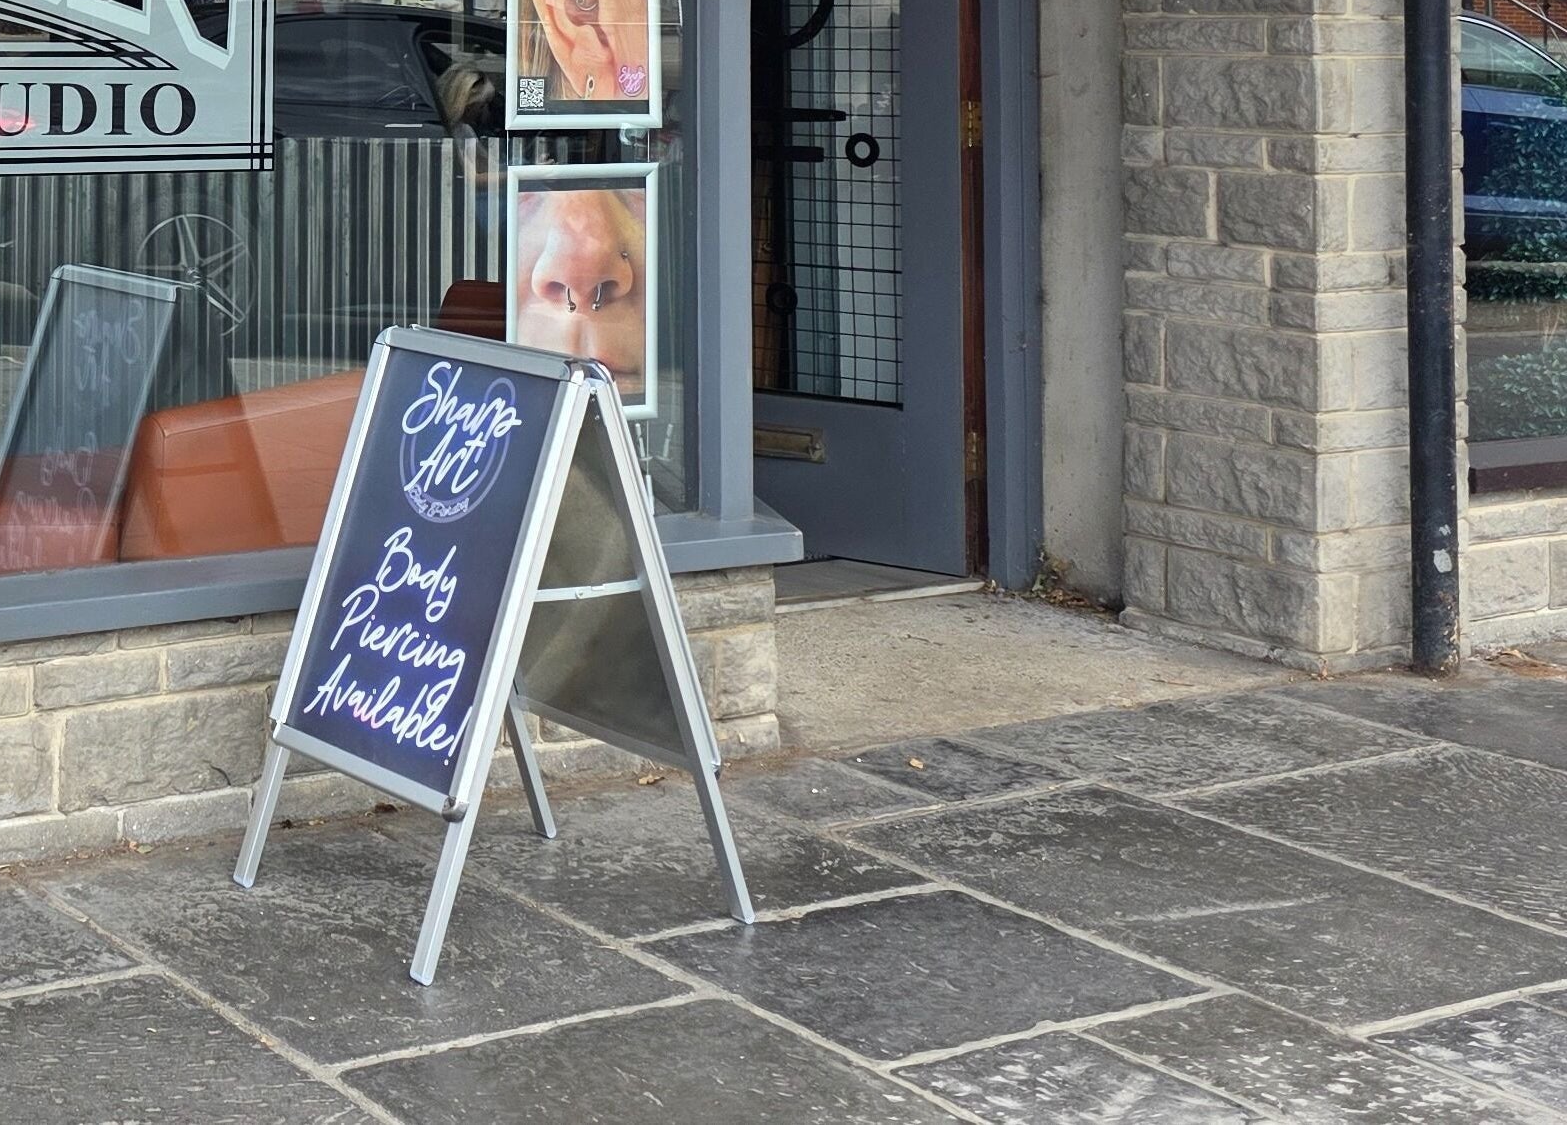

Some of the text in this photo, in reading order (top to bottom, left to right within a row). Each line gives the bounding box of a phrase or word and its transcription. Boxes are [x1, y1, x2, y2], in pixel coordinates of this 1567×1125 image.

[402, 361, 522, 457] Sharp
[404, 424, 487, 494] Art
[375, 526, 458, 623] Body
[330, 583, 466, 707] Piercing
[303, 653, 473, 766] Available!
